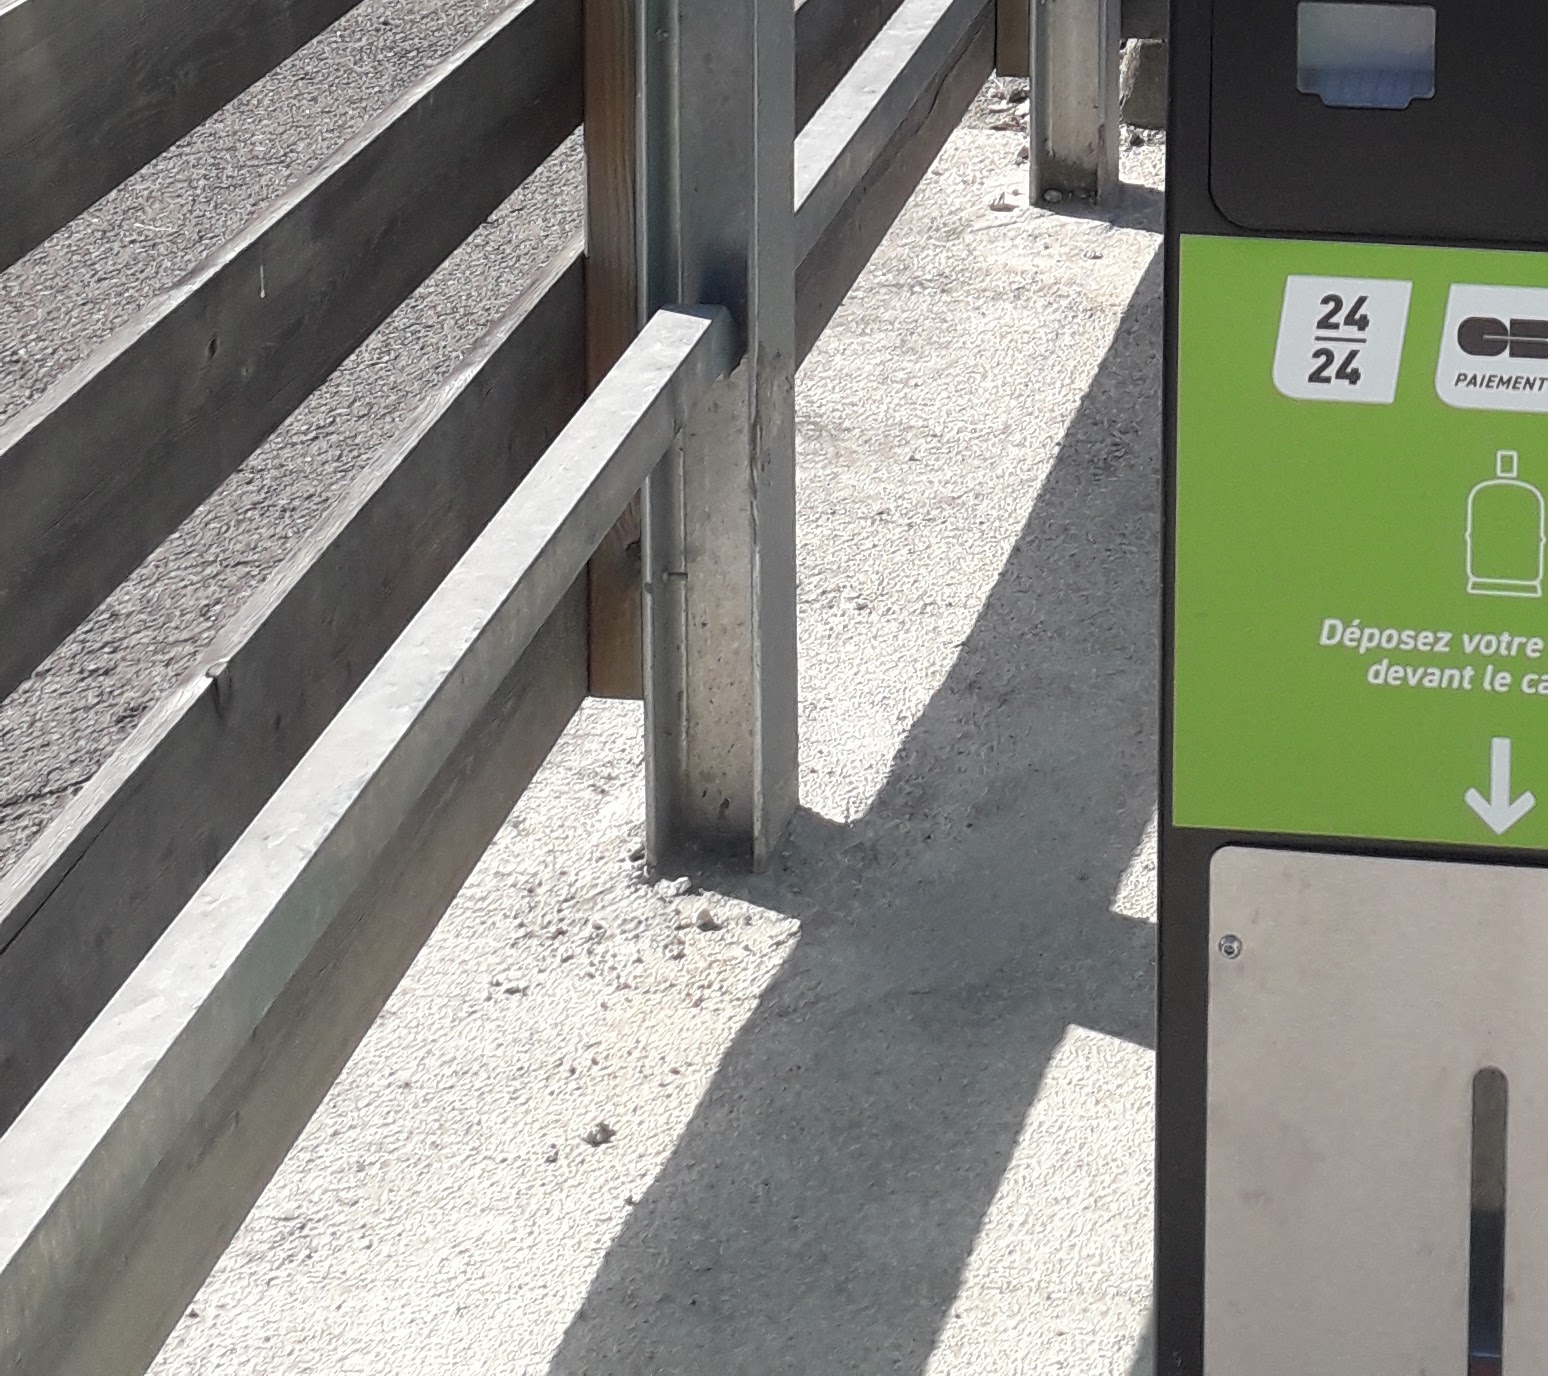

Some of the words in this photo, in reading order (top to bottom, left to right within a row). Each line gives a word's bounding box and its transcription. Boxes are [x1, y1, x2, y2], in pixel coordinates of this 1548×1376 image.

[1315, 293, 1370, 332] 24
[1307, 347, 1362, 386] 24
[1319, 617, 1453, 654] Déposez
[1462, 631, 1545, 659] votre
[1366, 657, 1475, 690] devant
[1482, 664, 1512, 693] le
